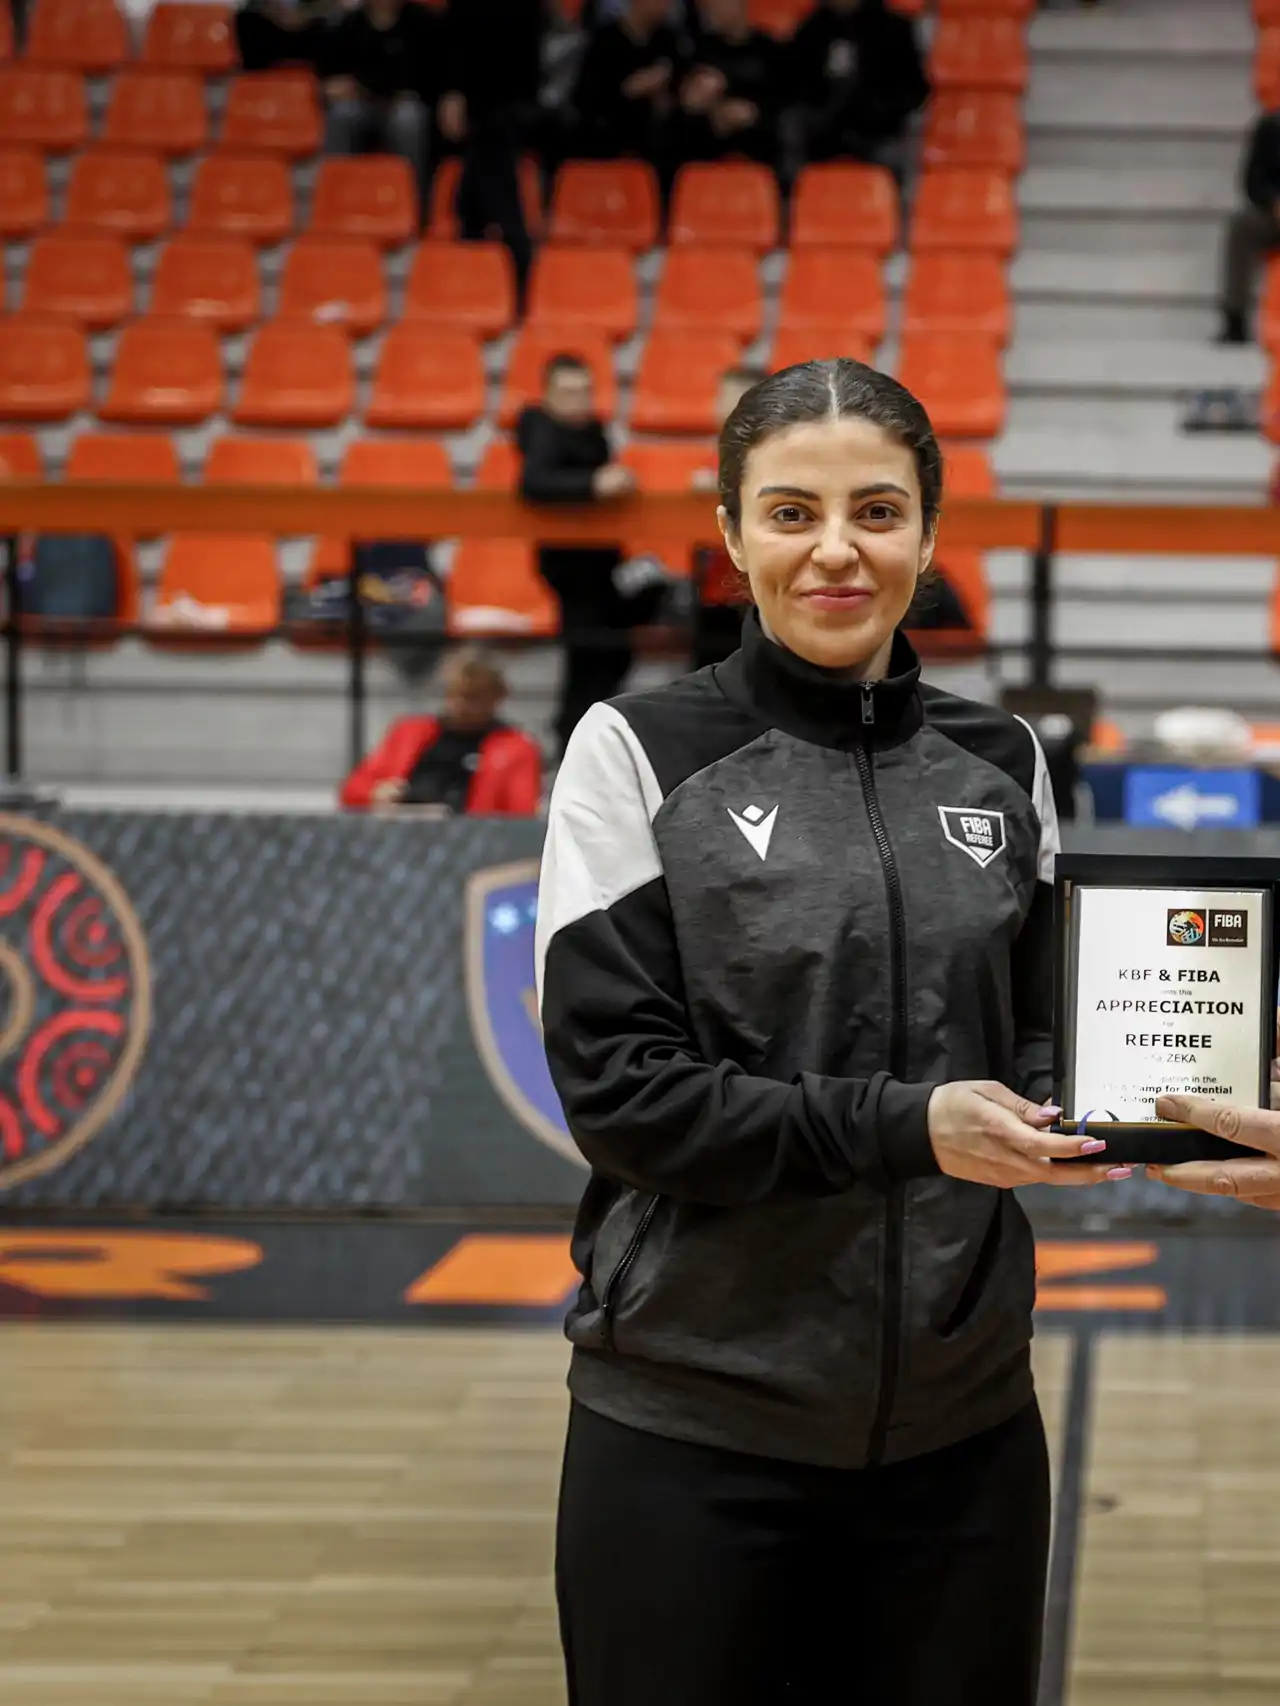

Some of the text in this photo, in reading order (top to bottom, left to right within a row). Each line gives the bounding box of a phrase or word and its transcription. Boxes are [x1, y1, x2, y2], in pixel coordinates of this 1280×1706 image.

[960, 816, 992, 836] FIBA
[1214, 914, 1242, 928] FIBA
[1119, 968, 1221, 983] KBF & FIBA
[1096, 999, 1244, 1015] APPRECIATION
[1125, 1033, 1212, 1049] REFEREE
[1166, 1053, 1197, 1063] ZEKA
[1192, 1075, 1200, 1083] in
[1202, 1075, 1217, 1083] the
[1165, 1085, 1180, 1093] for
[1184, 1085, 1233, 1095] Potential
